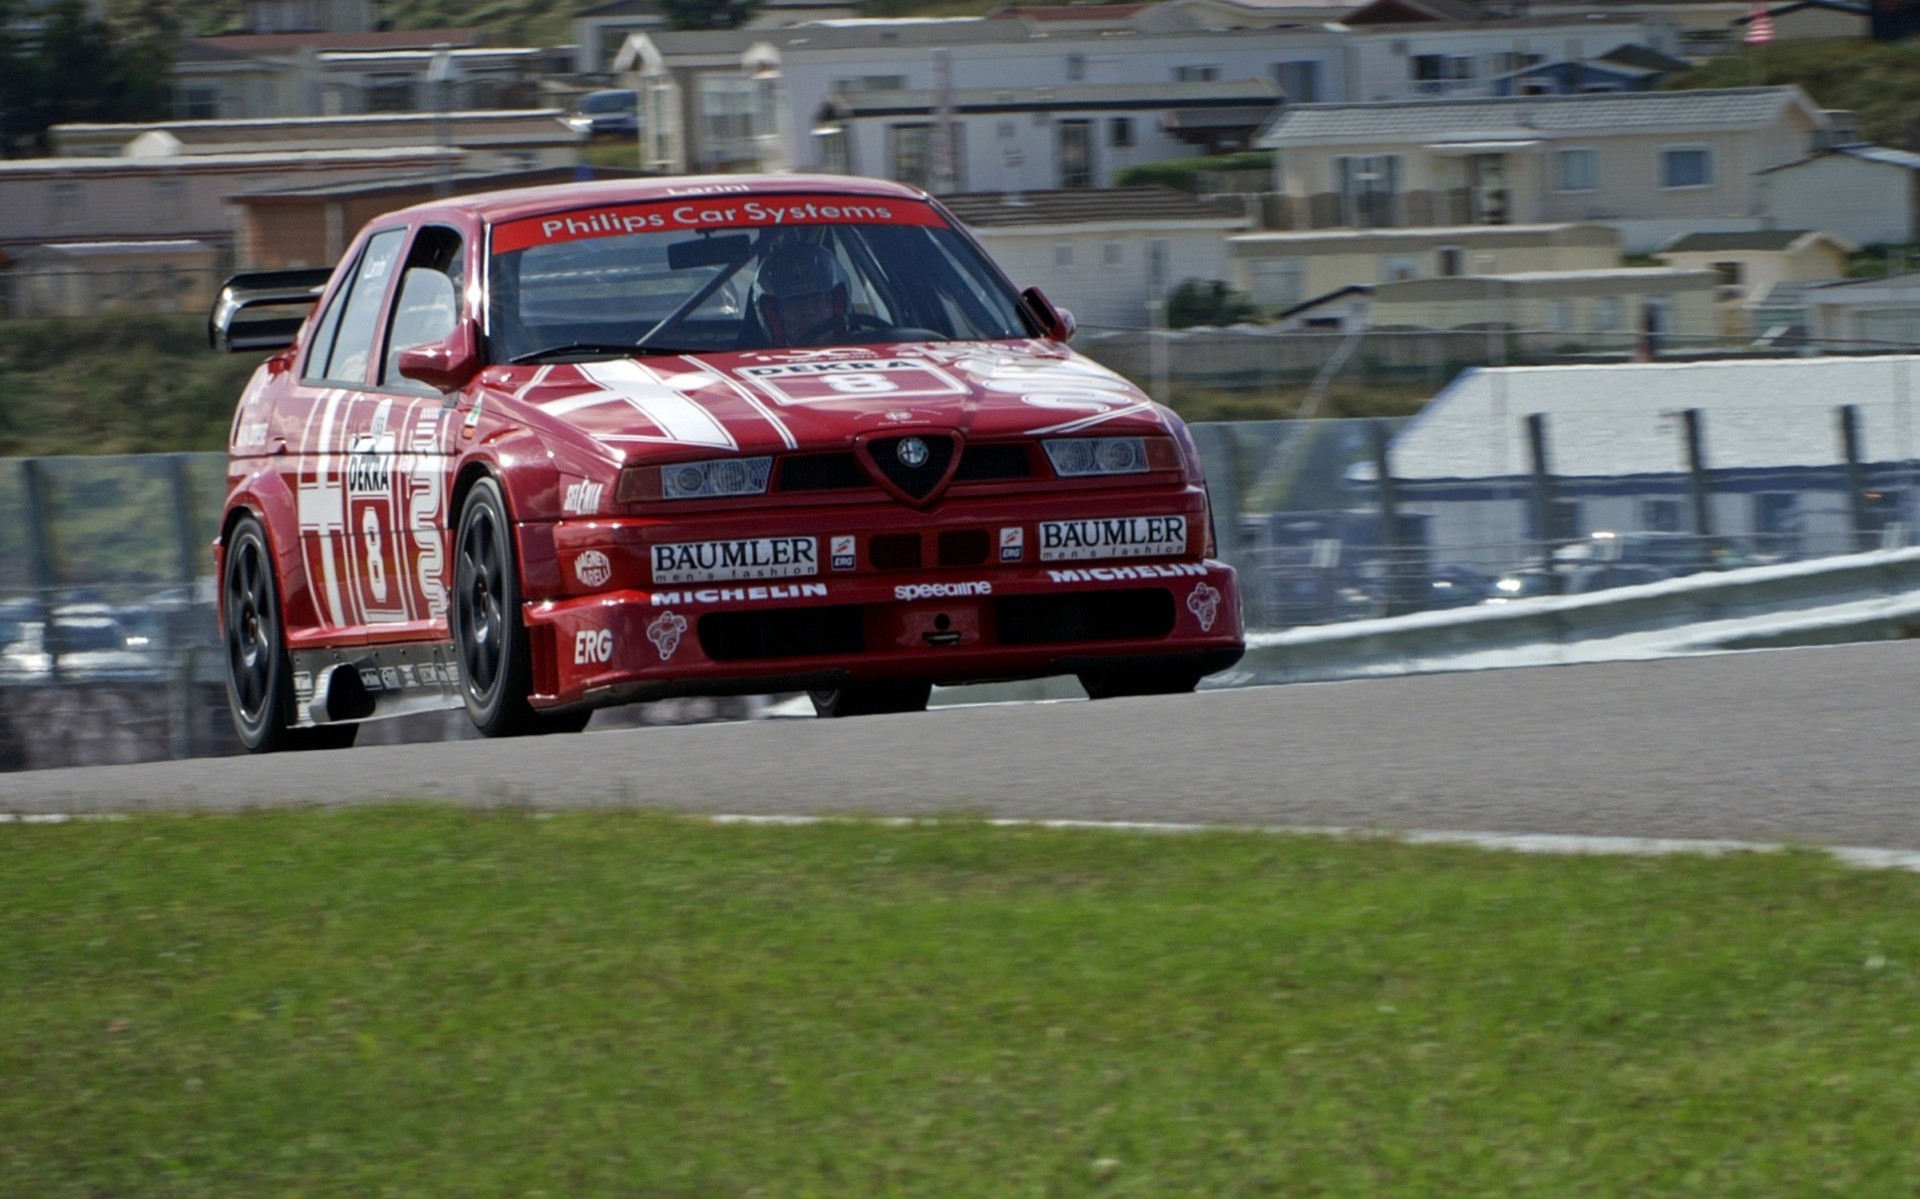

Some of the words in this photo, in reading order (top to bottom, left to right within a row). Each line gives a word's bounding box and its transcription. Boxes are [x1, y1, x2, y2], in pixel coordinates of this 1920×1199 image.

[666, 184, 751, 197] Larini
[542, 213, 665, 238] Philips
[672, 206, 737, 224] Car
[743, 202, 893, 223] Systems
[749, 359, 922, 377] DEKRA
[819, 373, 900, 393] 8
[349, 456, 390, 492] DEKRA
[1042, 516, 1185, 549] BÄUMLER
[362, 506, 388, 604] 8
[654, 538, 815, 572] BÄUMLER
[833, 556, 854, 568] ERG
[1042, 548, 1097, 559] men's
[1112, 545, 1184, 557] fashion
[655, 570, 715, 583] men's
[732, 565, 816, 580] fashion
[1047, 563, 1208, 583] MICHELIN
[651, 583, 828, 607] MICHELIN
[574, 629, 613, 665] ERG
